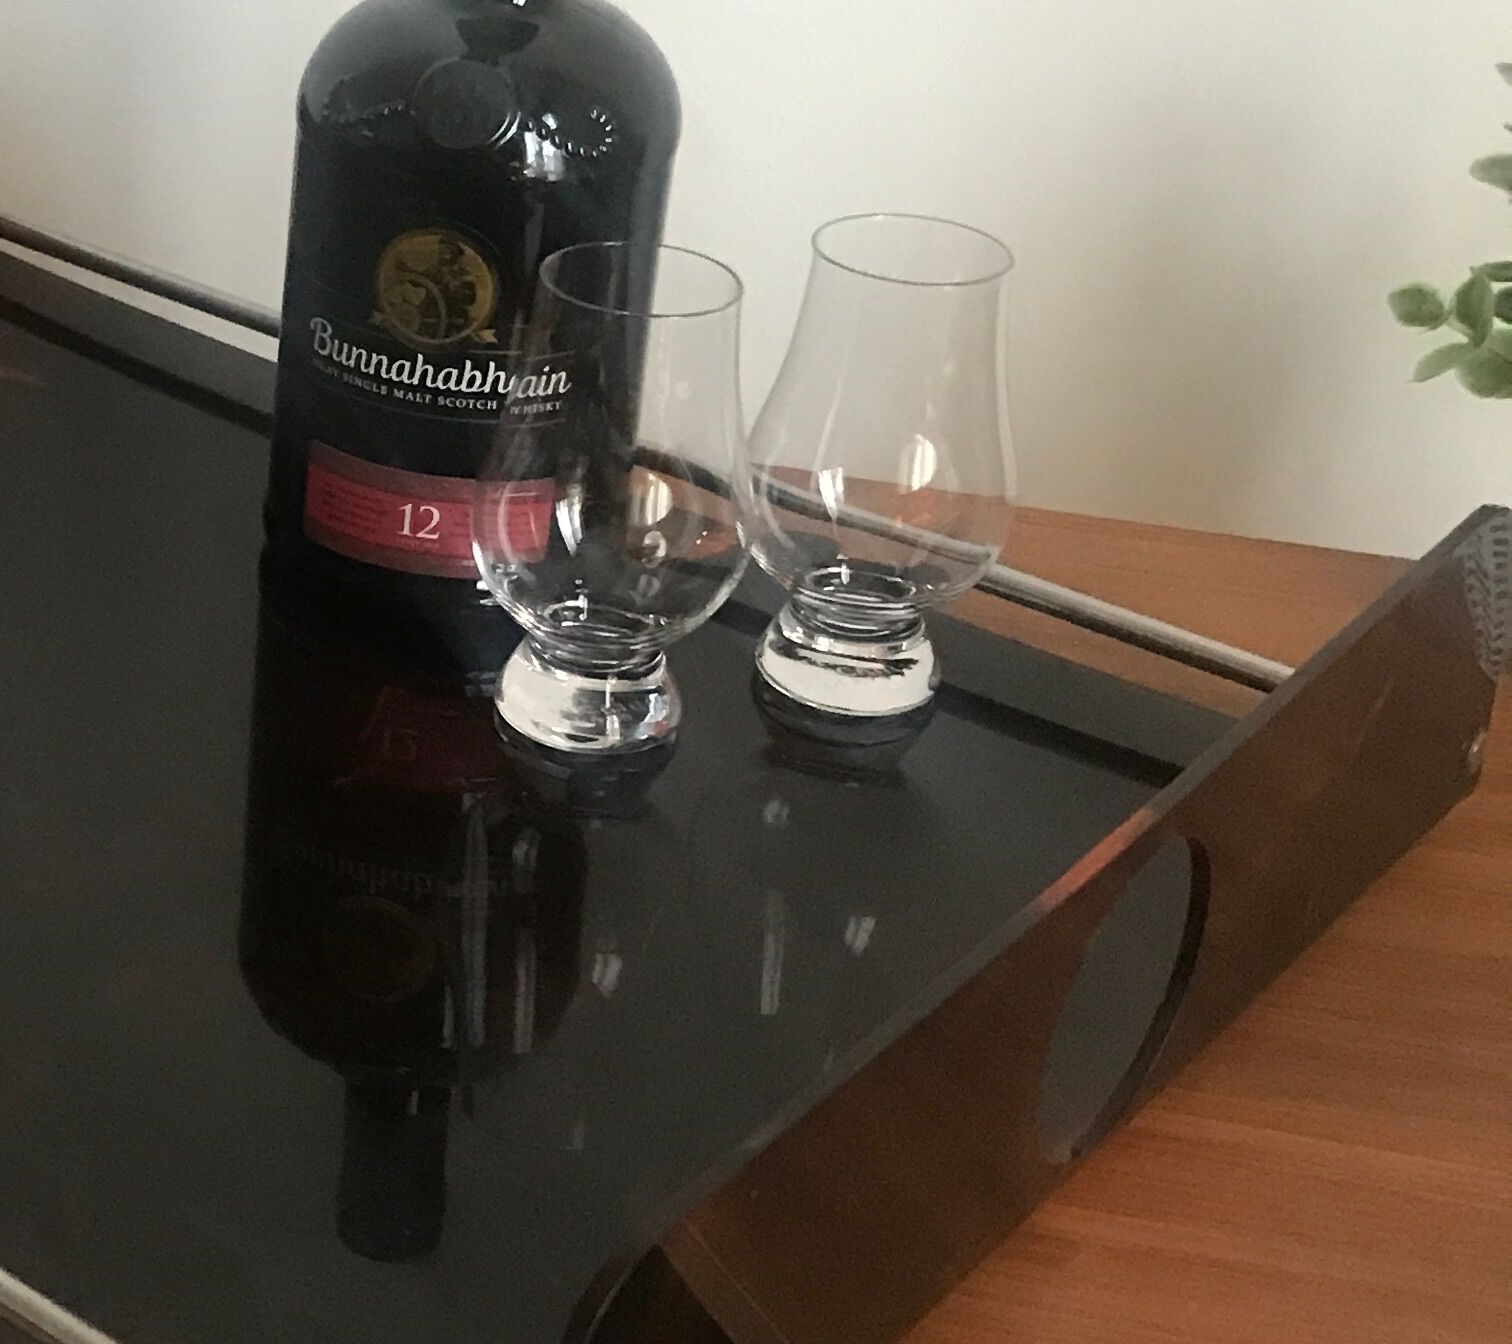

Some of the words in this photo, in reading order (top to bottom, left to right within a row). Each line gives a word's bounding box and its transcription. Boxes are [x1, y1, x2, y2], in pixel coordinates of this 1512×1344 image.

[310, 317, 572, 401] Bunnahabhain
[343, 372, 387, 395] SINGLE
[393, 386, 432, 405] MALT
[437, 395, 497, 410] SCOTCH
[398, 503, 440, 539] 12
